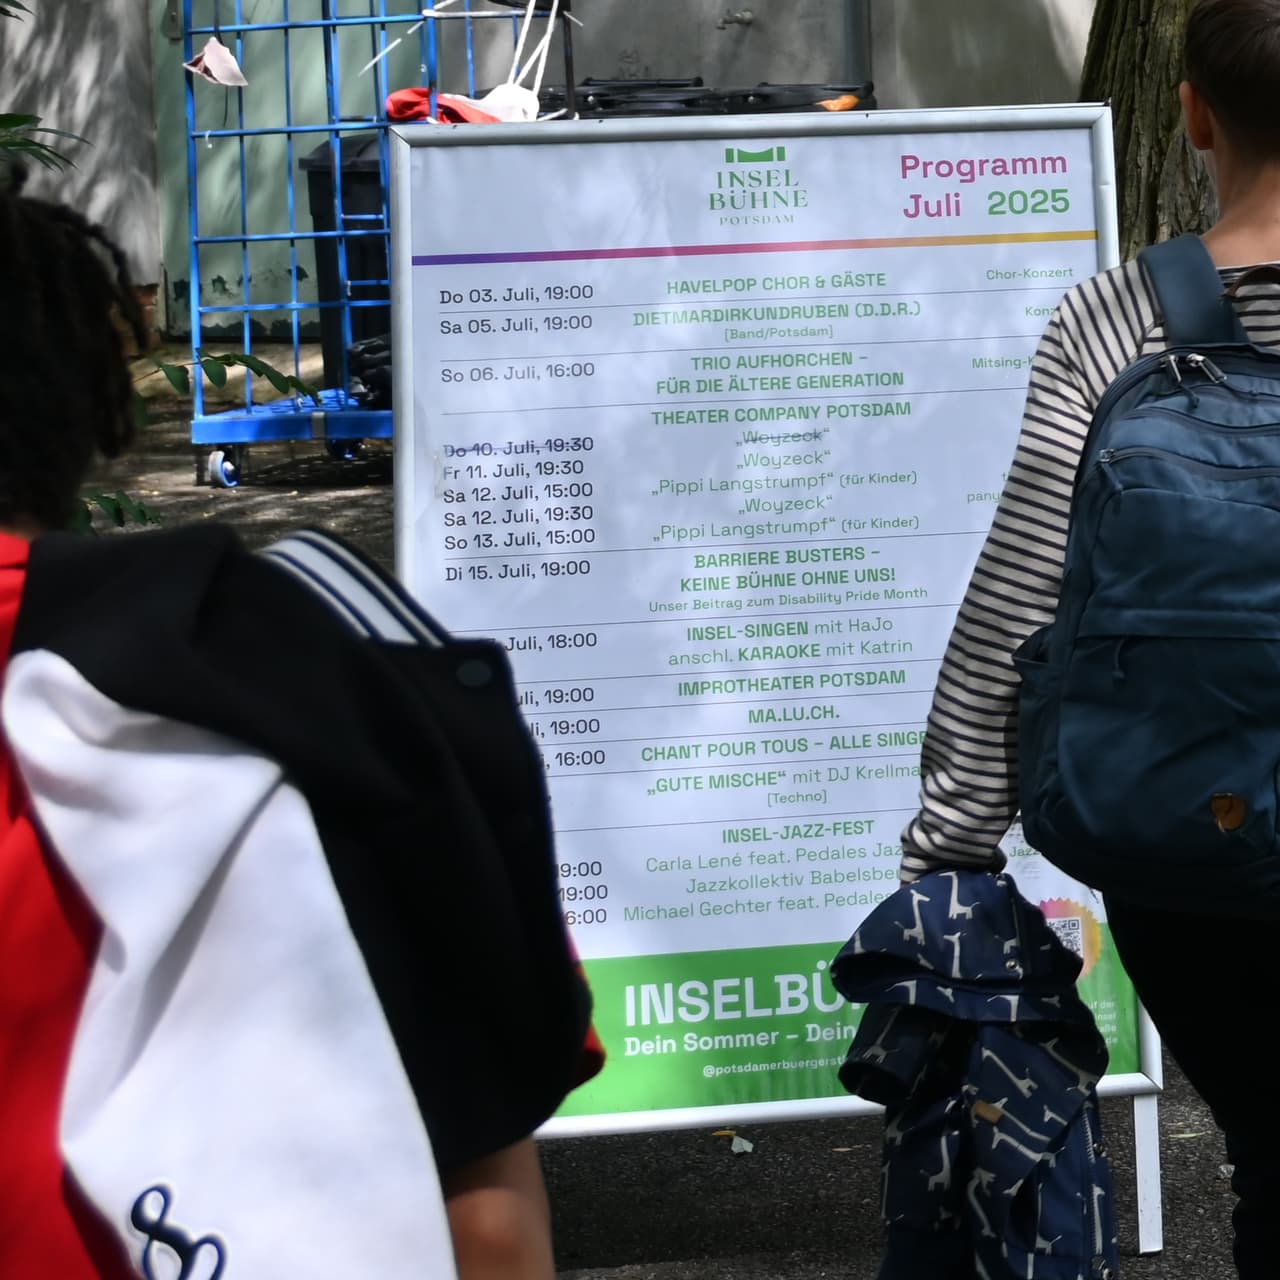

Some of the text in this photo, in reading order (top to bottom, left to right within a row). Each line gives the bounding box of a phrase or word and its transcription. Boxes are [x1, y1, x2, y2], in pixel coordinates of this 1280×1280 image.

[717, 169, 799, 189] INSEL
[901, 154, 1067, 183] Programm
[708, 189, 809, 211] BÜHNE
[903, 188, 1070, 219] Juli 2025
[719, 214, 795, 226] POTSDAM
[667, 270, 886, 295] HAVELPOP CHOR & GÄSTE
[986, 268, 1074, 281] Chor-Konzert
[440, 284, 593, 304] Do 03. Juli, 19:00
[633, 300, 921, 326] DIETMARDIRKUNDRUBEN (D.D.R.)
[440, 314, 593, 335] Sa 05. Juli, 19:00
[724, 325, 833, 342] [Band/Potsdam]
[691, 352, 853, 371] TRIO AUFHORCHEN
[441, 362, 595, 383] So 06. Juli, 16:00
[656, 372, 904, 395] FÜR DIE ÄLTERE GENERATION
[652, 402, 911, 425] THEATER COMPANY POTSDAM
[471, 442, 498, 457] 10.
[503, 440, 541, 455] Juli,
[544, 436, 594, 452] 19:30
[443, 460, 584, 480] Fr 11. Juli, 19:30
[839, 473, 864, 488] (für
[869, 470, 917, 485] Kinder)
[443, 482, 594, 503] Sa 12. Juli, 15:00
[443, 505, 594, 527] Sa 12. Juli, 19:30
[841, 518, 866, 534] (für
[870, 515, 920, 530] Kinder)
[444, 528, 596, 550] So 13. Juli, 15:00
[694, 546, 865, 569] BARRIERE BUSTERS
[445, 560, 591, 581] Di 15. Juli, 19:00
[680, 568, 896, 592] KEINE BÜHNE OHNE UNS!
[649, 587, 928, 613] Unser Beitrag zum Disability Pride Month
[687, 617, 893, 641] INSEL-SINGEN mit HaJo
[504, 632, 598, 652] Juli, 18:00
[668, 640, 913, 666] anschl. KARAOKE mit Katrin
[678, 670, 906, 697] IMPROTHEATER POTSDAM
[544, 687, 594, 703] 19:00
[748, 705, 840, 724] MA.LU.CH.
[550, 719, 600, 735] 19:00
[555, 750, 605, 766] 16:00
[641, 744, 703, 762] CHANT
[707, 742, 756, 757] POUR
[761, 738, 808, 755] TOUS
[829, 734, 872, 750] ALLE
[793, 770, 821, 785] mit
[828, 766, 850, 782] DJ
[767, 789, 827, 808] [Techno]
[723, 820, 875, 844] INSEL-JAZZ-FEST
[646, 856, 692, 873] Carla
[698, 852, 742, 869] Lené
[748, 848, 791, 865] feat.
[795, 845, 867, 862] Pedales
[685, 873, 804, 894] Jazzkollektiv
[623, 904, 694, 922] Michael
[700, 900, 771, 917] Gechter
[777, 895, 819, 912] feat.
[625, 960, 861, 1027] INSELBÜ
[624, 1035, 676, 1056] Dein
[684, 1031, 779, 1051] Sommer
